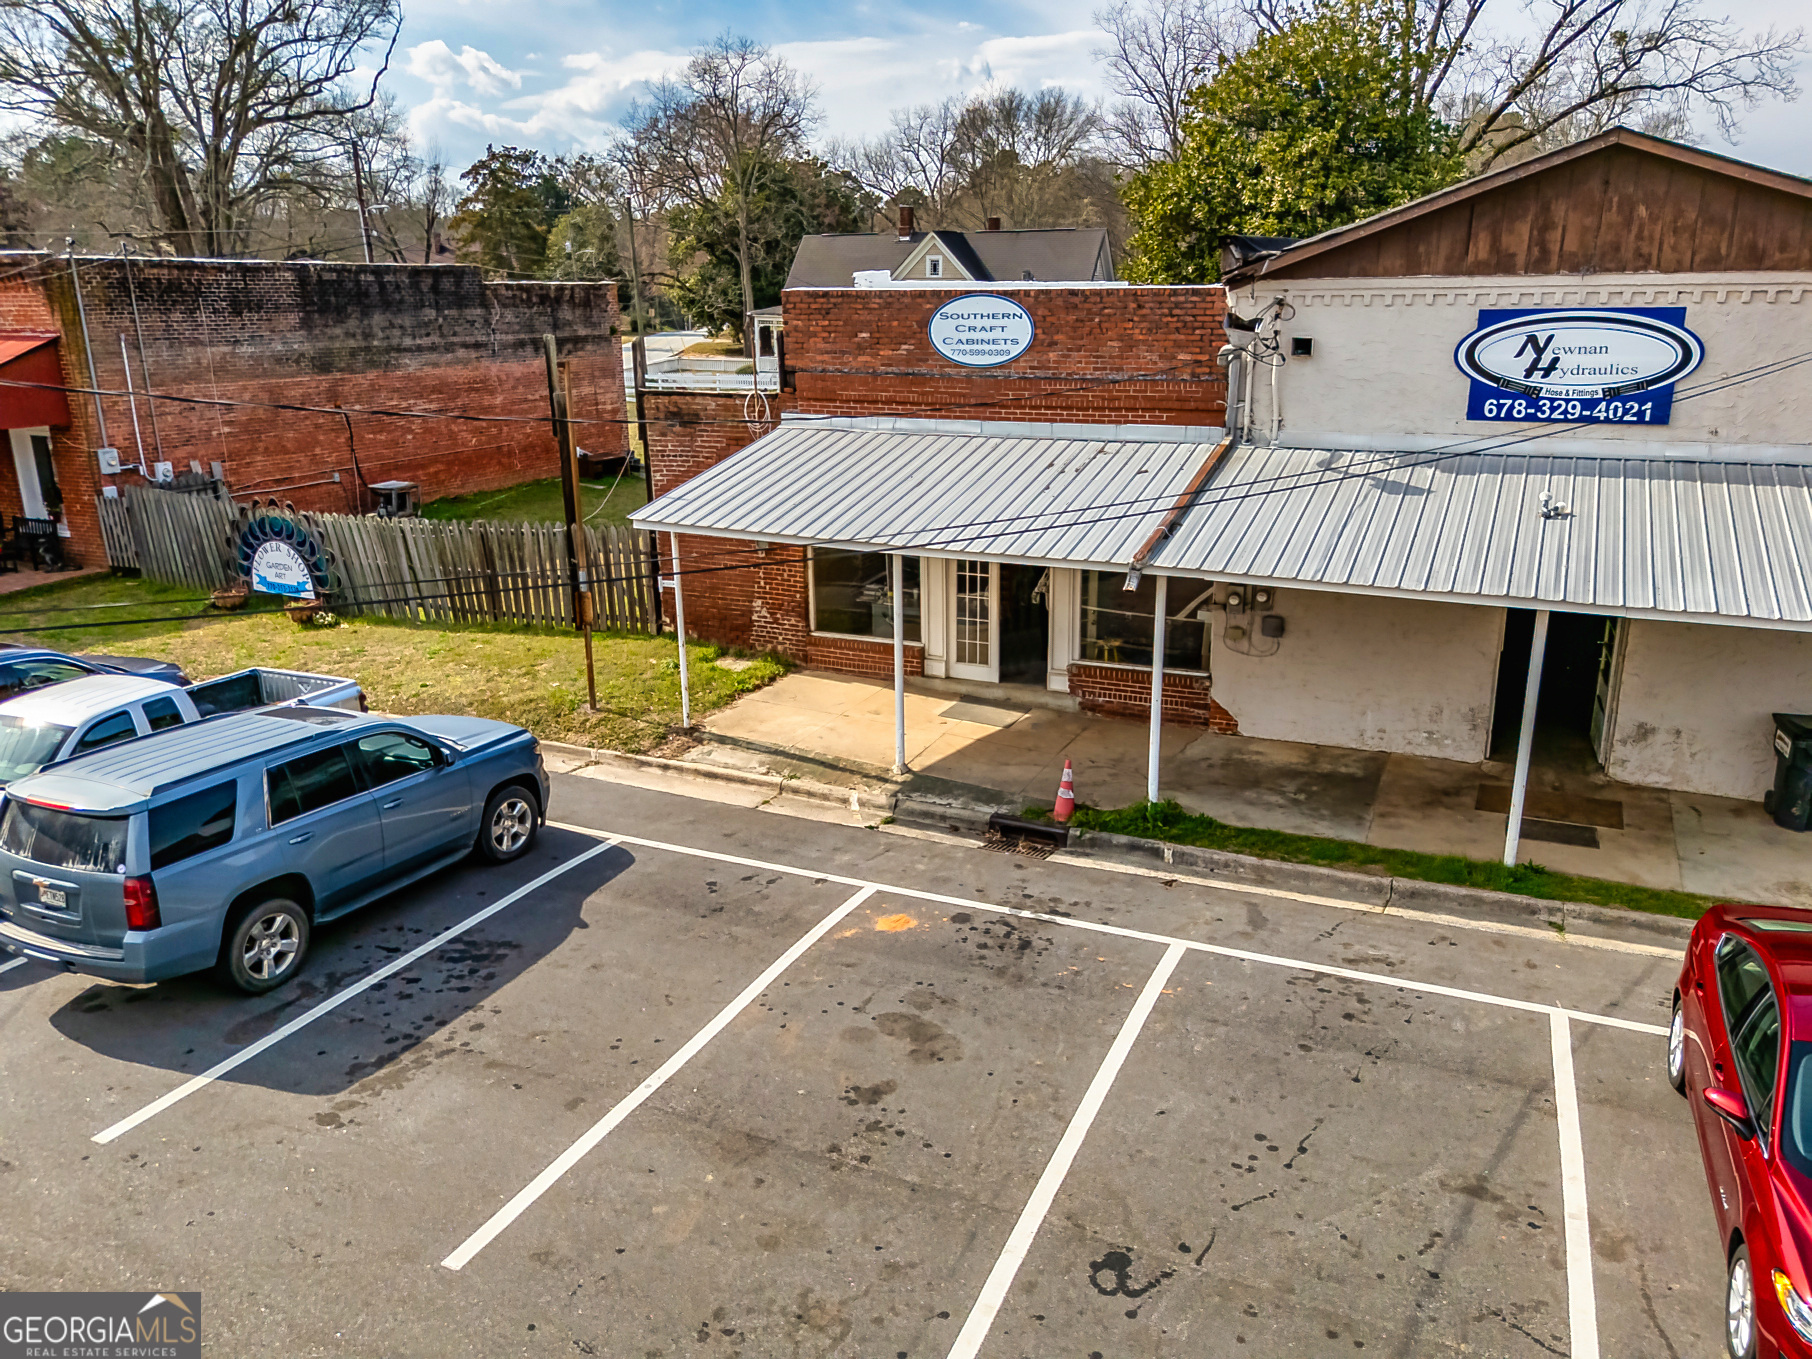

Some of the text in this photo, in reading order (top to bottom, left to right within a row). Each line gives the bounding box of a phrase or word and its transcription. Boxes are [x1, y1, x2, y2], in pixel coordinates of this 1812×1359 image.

[939, 312, 1023, 320] SOUTHERN
[955, 324, 1008, 333] CRAFT
[942, 337, 1020, 346] CABINETS
[1513, 333, 1609, 359] Newnan
[950, 348, 1011, 356] 770-599-0309
[1523, 355, 1639, 379] Hydraulics
[1545, 387, 1599, 398] Hose & Fittings
[1483, 399, 1653, 422] 678-329-4021
[253, 542, 310, 581] FLOWER SHOP
[265, 561, 293, 572] GARDEN
[274, 572, 287, 580] ART
